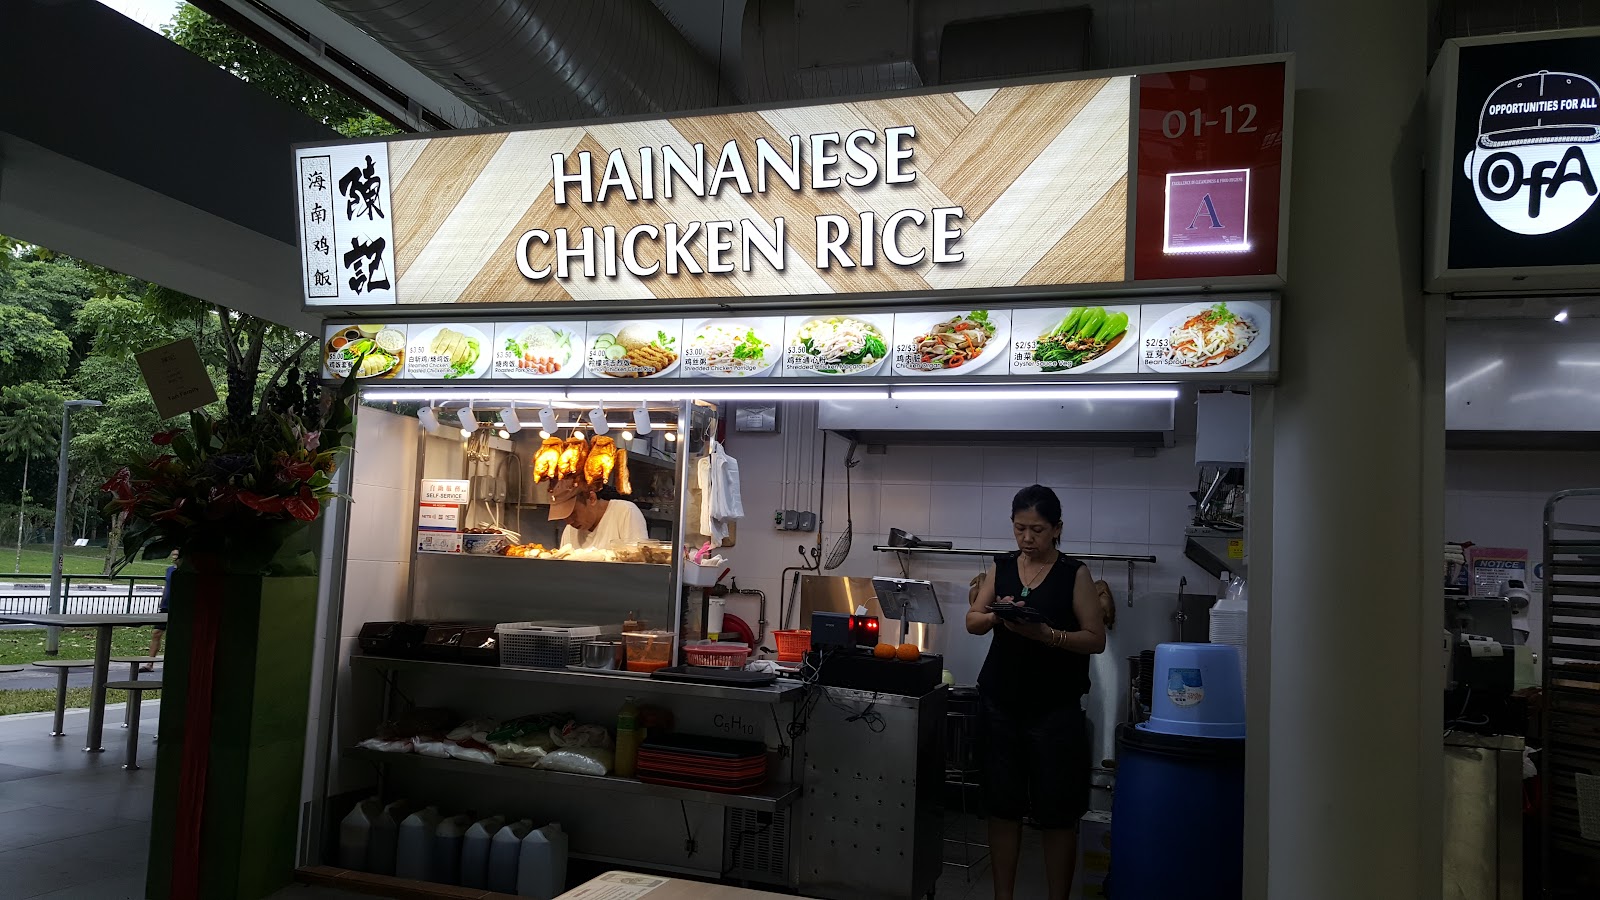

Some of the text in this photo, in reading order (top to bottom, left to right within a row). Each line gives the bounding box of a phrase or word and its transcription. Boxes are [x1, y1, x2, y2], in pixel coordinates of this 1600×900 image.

[1488, 97, 1598, 116] OPPORTUNITIES FOR ALL
[1162, 103, 1258, 139] 01-12
[551, 125, 917, 205] HAINANESE
[1478, 145, 1598, 218] OfA
[1185, 192, 1226, 230] A
[338, 155, 391, 295] 陳記
[515, 206, 966, 281] CHICKEN RICE
[1015, 341, 1036, 350] $2/$3
[1145, 338, 1169, 348] $2/$3
[409, 346, 425, 354] $3.50
[685, 348, 703, 356] $3.00
[787, 346, 806, 354] $3.50
[896, 344, 917, 353] $2/$3
[329, 353, 344, 361] $5.00
[496, 351, 512, 359] $3.50
[1013, 352, 1032, 361] 油菜
[1145, 349, 1164, 359] 豆芽
[1058, 360, 1073, 368] Veg
[1164, 358, 1187, 366] Sprout
[1479, 560, 1520, 569] NOTICE
